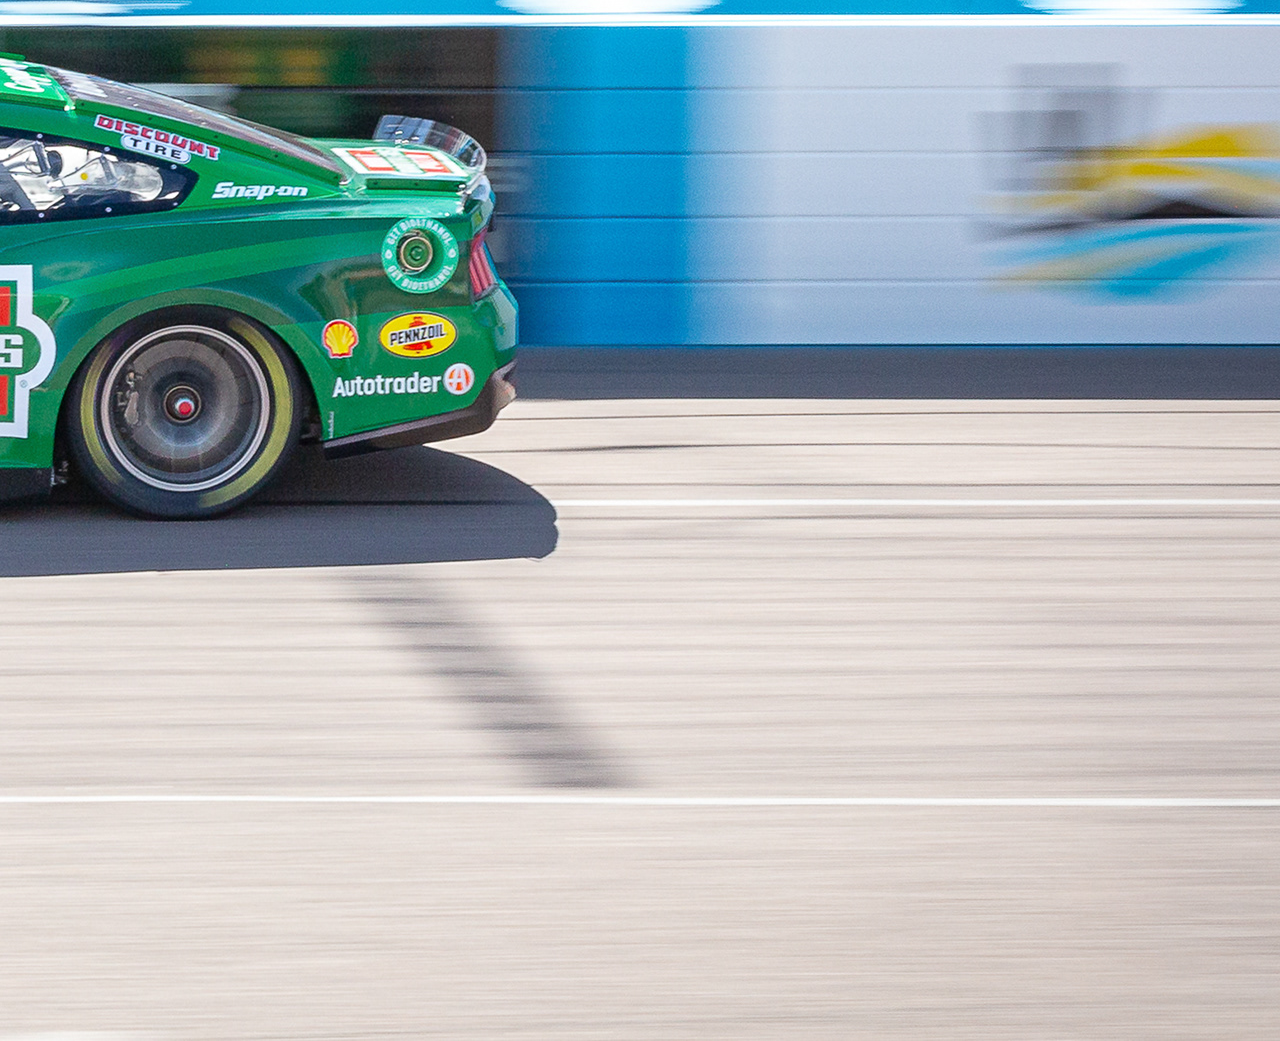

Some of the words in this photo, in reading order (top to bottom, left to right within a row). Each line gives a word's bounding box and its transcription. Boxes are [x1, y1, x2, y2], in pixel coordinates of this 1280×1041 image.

[94, 114, 222, 161] DISCOUNT
[129, 137, 183, 160] TIRE
[212, 182, 309, 200] Snap-on
[386, 227, 401, 245] GET
[399, 218, 454, 248] BIOETHANOL
[387, 265, 404, 281] GET
[400, 264, 455, 291] BIOETHANOL
[388, 322, 448, 346] PENNZOIL
[332, 371, 443, 399] Autotrader
